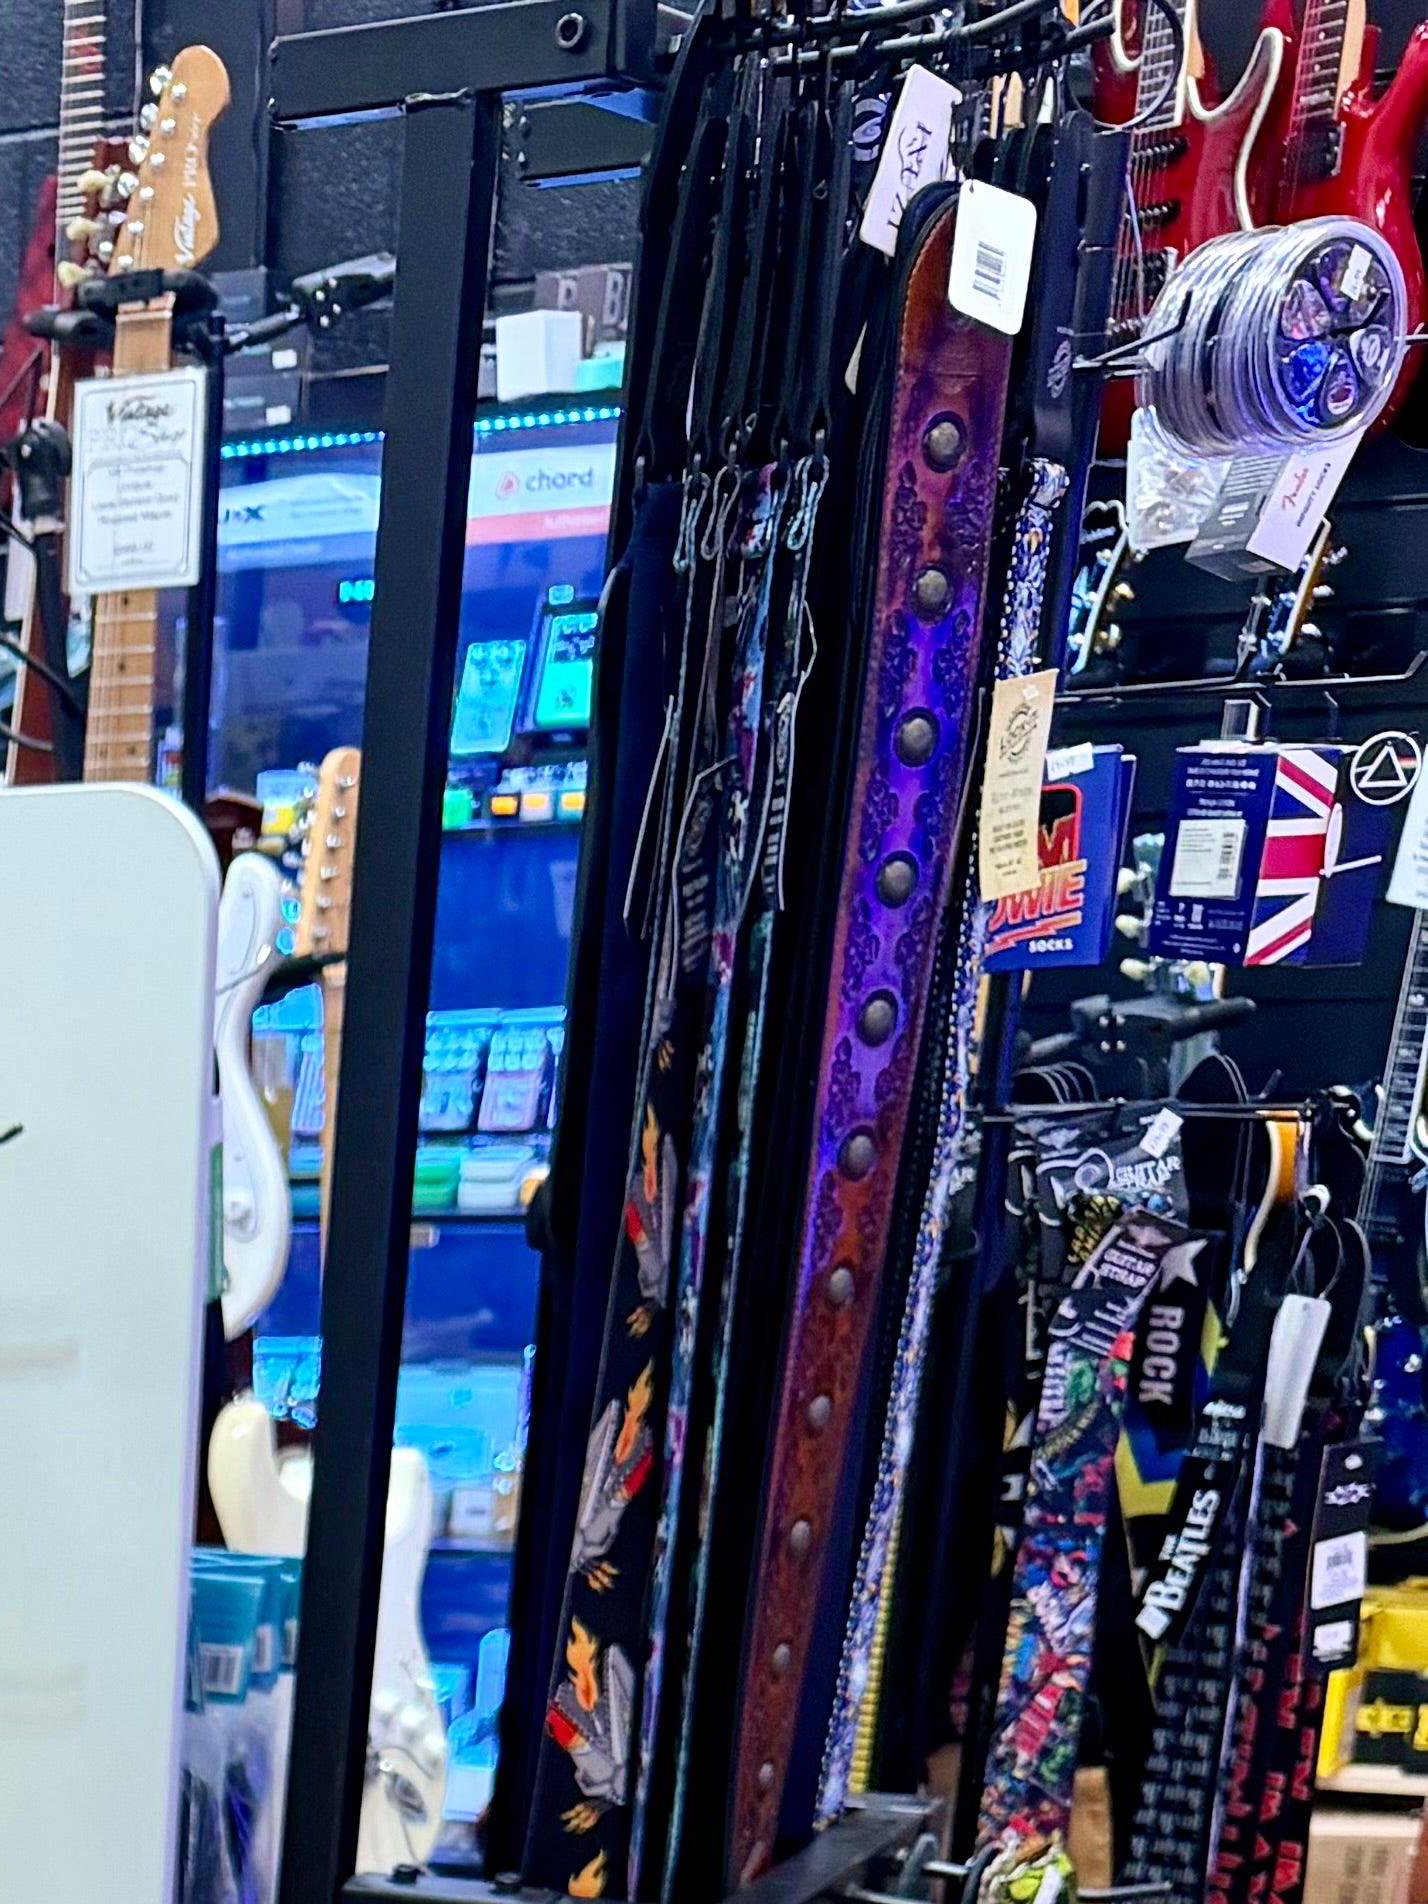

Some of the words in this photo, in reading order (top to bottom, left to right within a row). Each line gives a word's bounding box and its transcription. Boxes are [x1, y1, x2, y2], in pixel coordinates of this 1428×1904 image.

[526, 468, 593, 493] chord
[1028, 938, 1074, 953] SOCKS
[1139, 1304, 1185, 1405] ROCK
[1142, 1489, 1221, 1611] BEATLES
